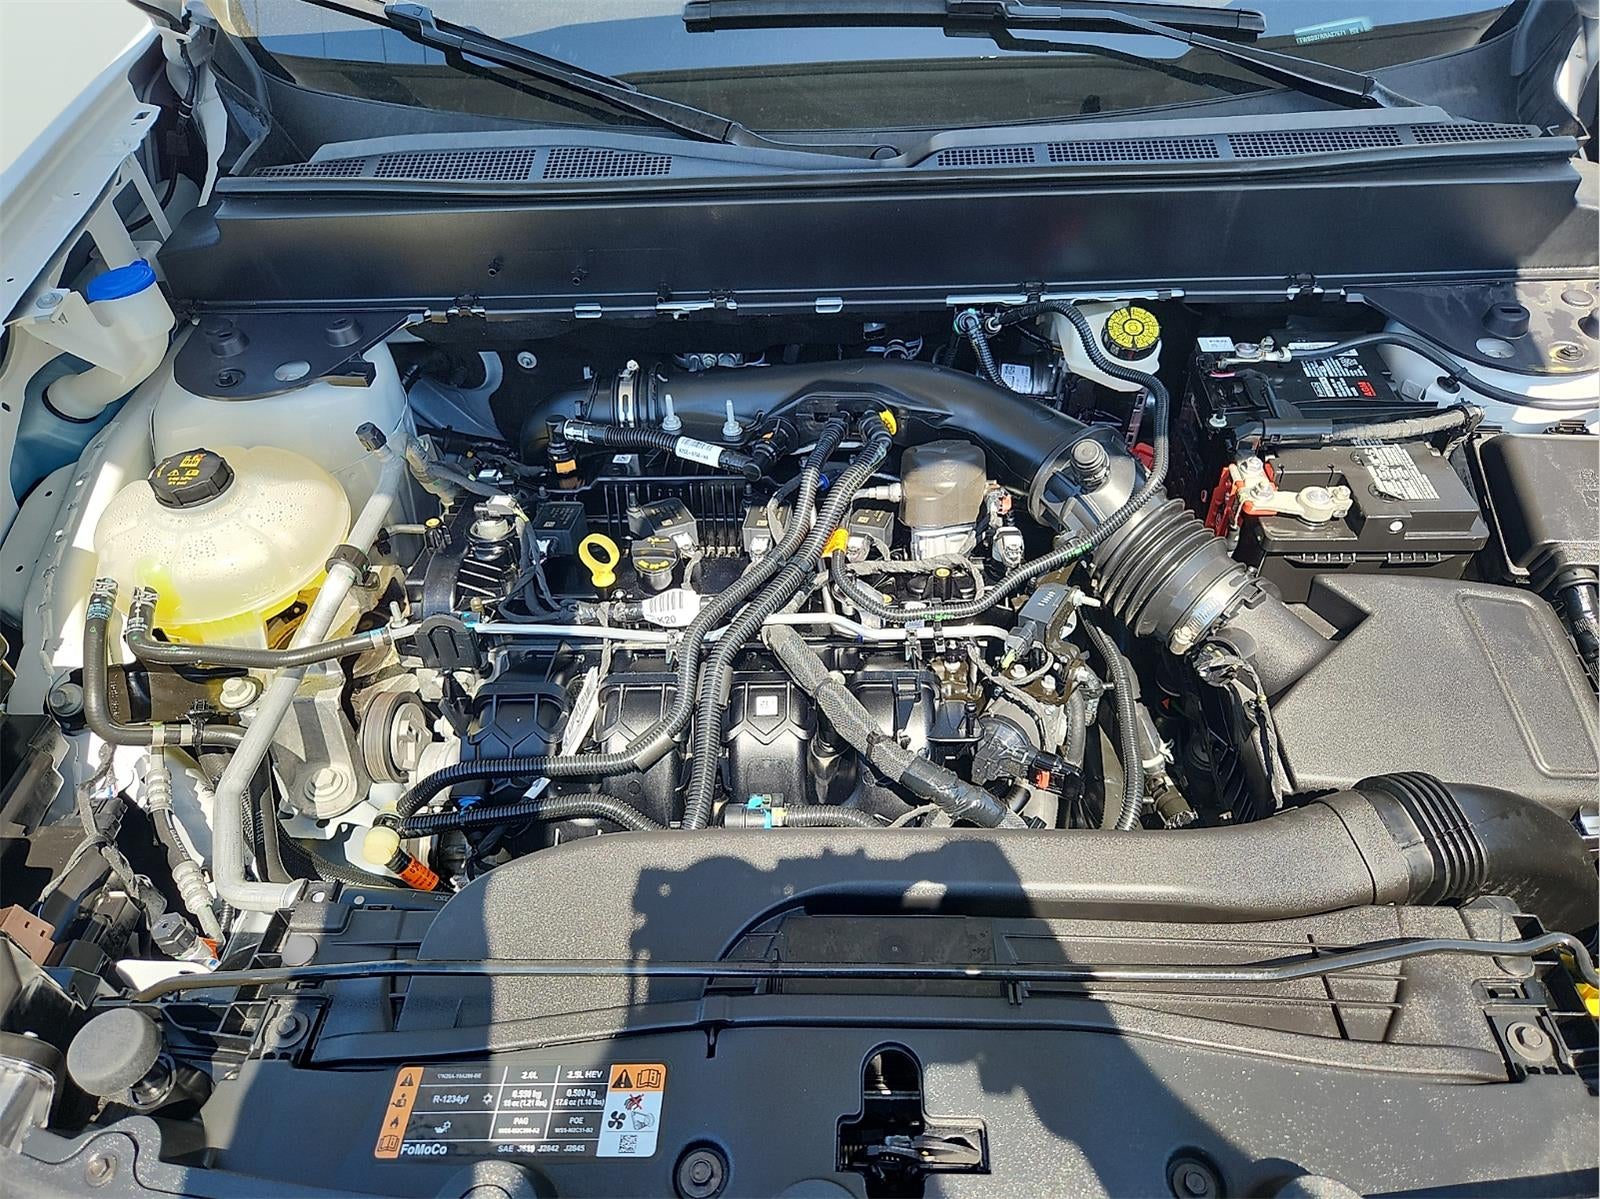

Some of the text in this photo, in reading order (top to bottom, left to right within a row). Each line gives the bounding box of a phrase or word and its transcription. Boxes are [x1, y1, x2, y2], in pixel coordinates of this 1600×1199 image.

[657, 615, 677, 625] K20
[521, 1071, 539, 1080] 2.0L
[566, 1070, 603, 1079] 2.5L HEV
[532, 1090, 542, 1100] kg
[566, 1089, 597, 1099] 0.500 kg
[432, 1094, 470, 1105] R-1234yf
[577, 1099, 592, 1107] (1.10
[592, 1099, 605, 1107] lbs)
[512, 1117, 529, 1125] PAG
[568, 1117, 584, 1125] POE
[399, 1143, 448, 1155] FoMoCo
[497, 1145, 514, 1153] SAE
